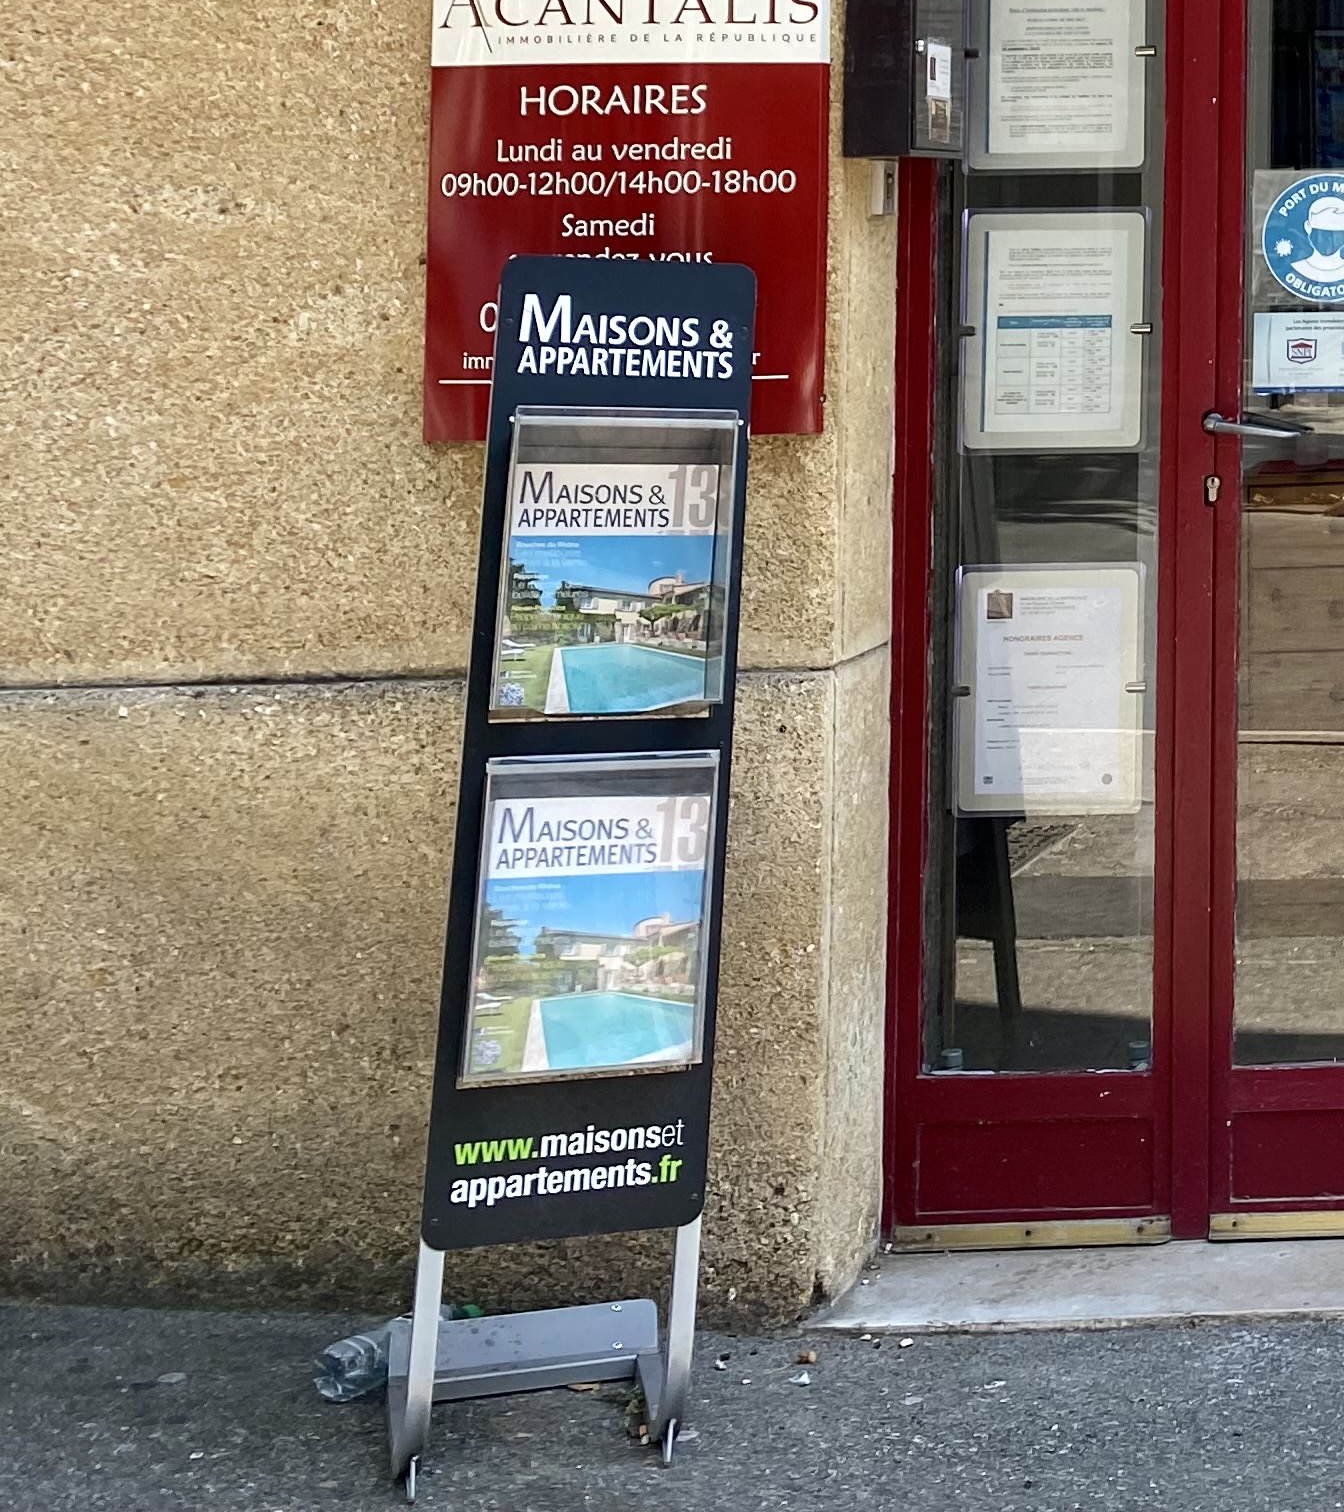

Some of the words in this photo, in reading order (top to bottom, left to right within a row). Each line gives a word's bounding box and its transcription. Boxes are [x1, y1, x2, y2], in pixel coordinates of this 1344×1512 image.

[630, 33, 651, 43] DE
[663, 33, 685, 43] LA
[696, 31, 818, 44] RÉPUBLIQUE
[519, 84, 709, 117] HORAIRES
[496, 138, 564, 163] Lundi
[571, 144, 603, 162] au
[611, 136, 733, 161] vendredi
[440, 169, 797, 198] 09h00-12h00/14h00-18h00
[1278, 188, 1307, 218] PORT
[1309, 182, 1330, 197] DU
[561, 213, 656, 237] Samedi
[710, 320, 734, 349] &
[517, 346, 734, 379] APPARTEMENTS
[648, 483, 666, 505] &
[668, 464, 717, 529] 13
[518, 507, 670, 529] APPARTEMENTS
[635, 818, 655, 840] &
[656, 797, 708, 865] 13
[496, 843, 657, 870] APPARTEMENTS
[454, 1118, 686, 1166] www.maisonset
[451, 1155, 683, 1208] appartements.fr
